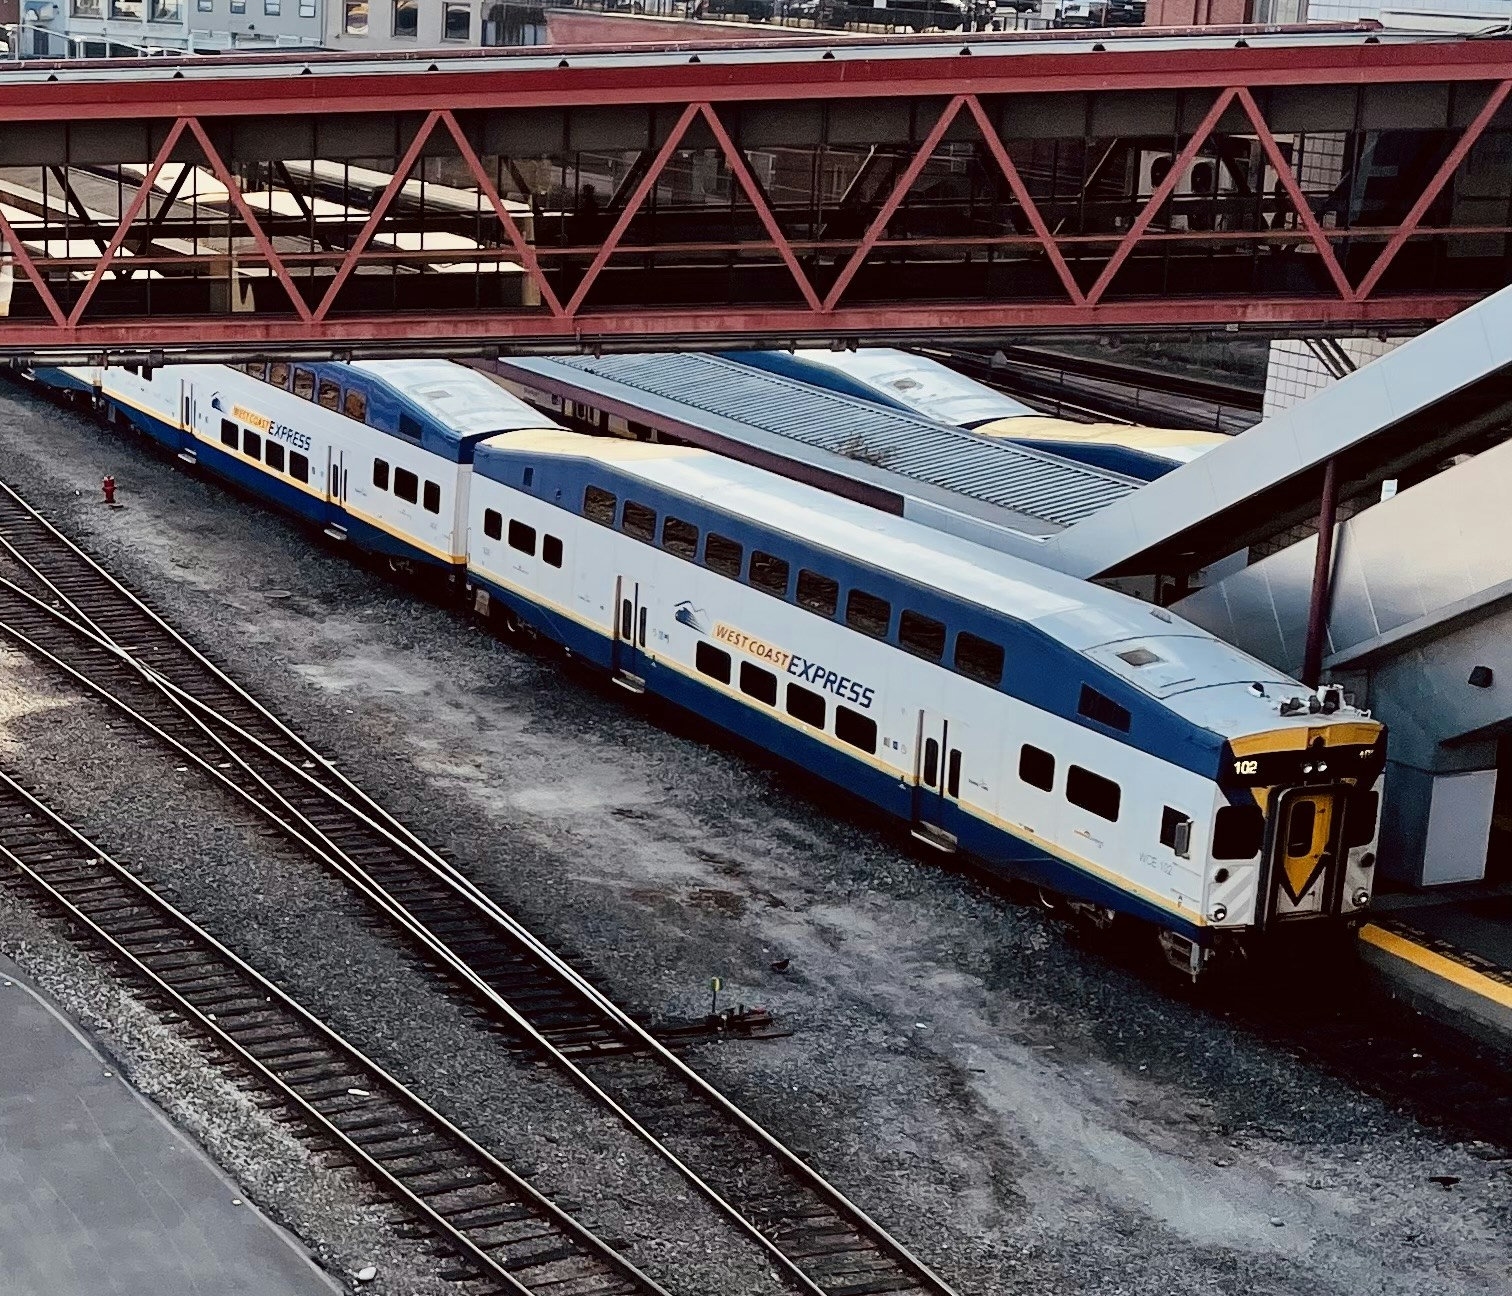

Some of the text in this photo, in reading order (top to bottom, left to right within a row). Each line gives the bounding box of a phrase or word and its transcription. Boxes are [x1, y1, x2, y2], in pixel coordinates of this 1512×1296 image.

[268, 421, 312, 451] EXPRESS
[716, 624, 875, 709] WEST COAST EXPRESS
[1234, 760, 1258, 775] 102
